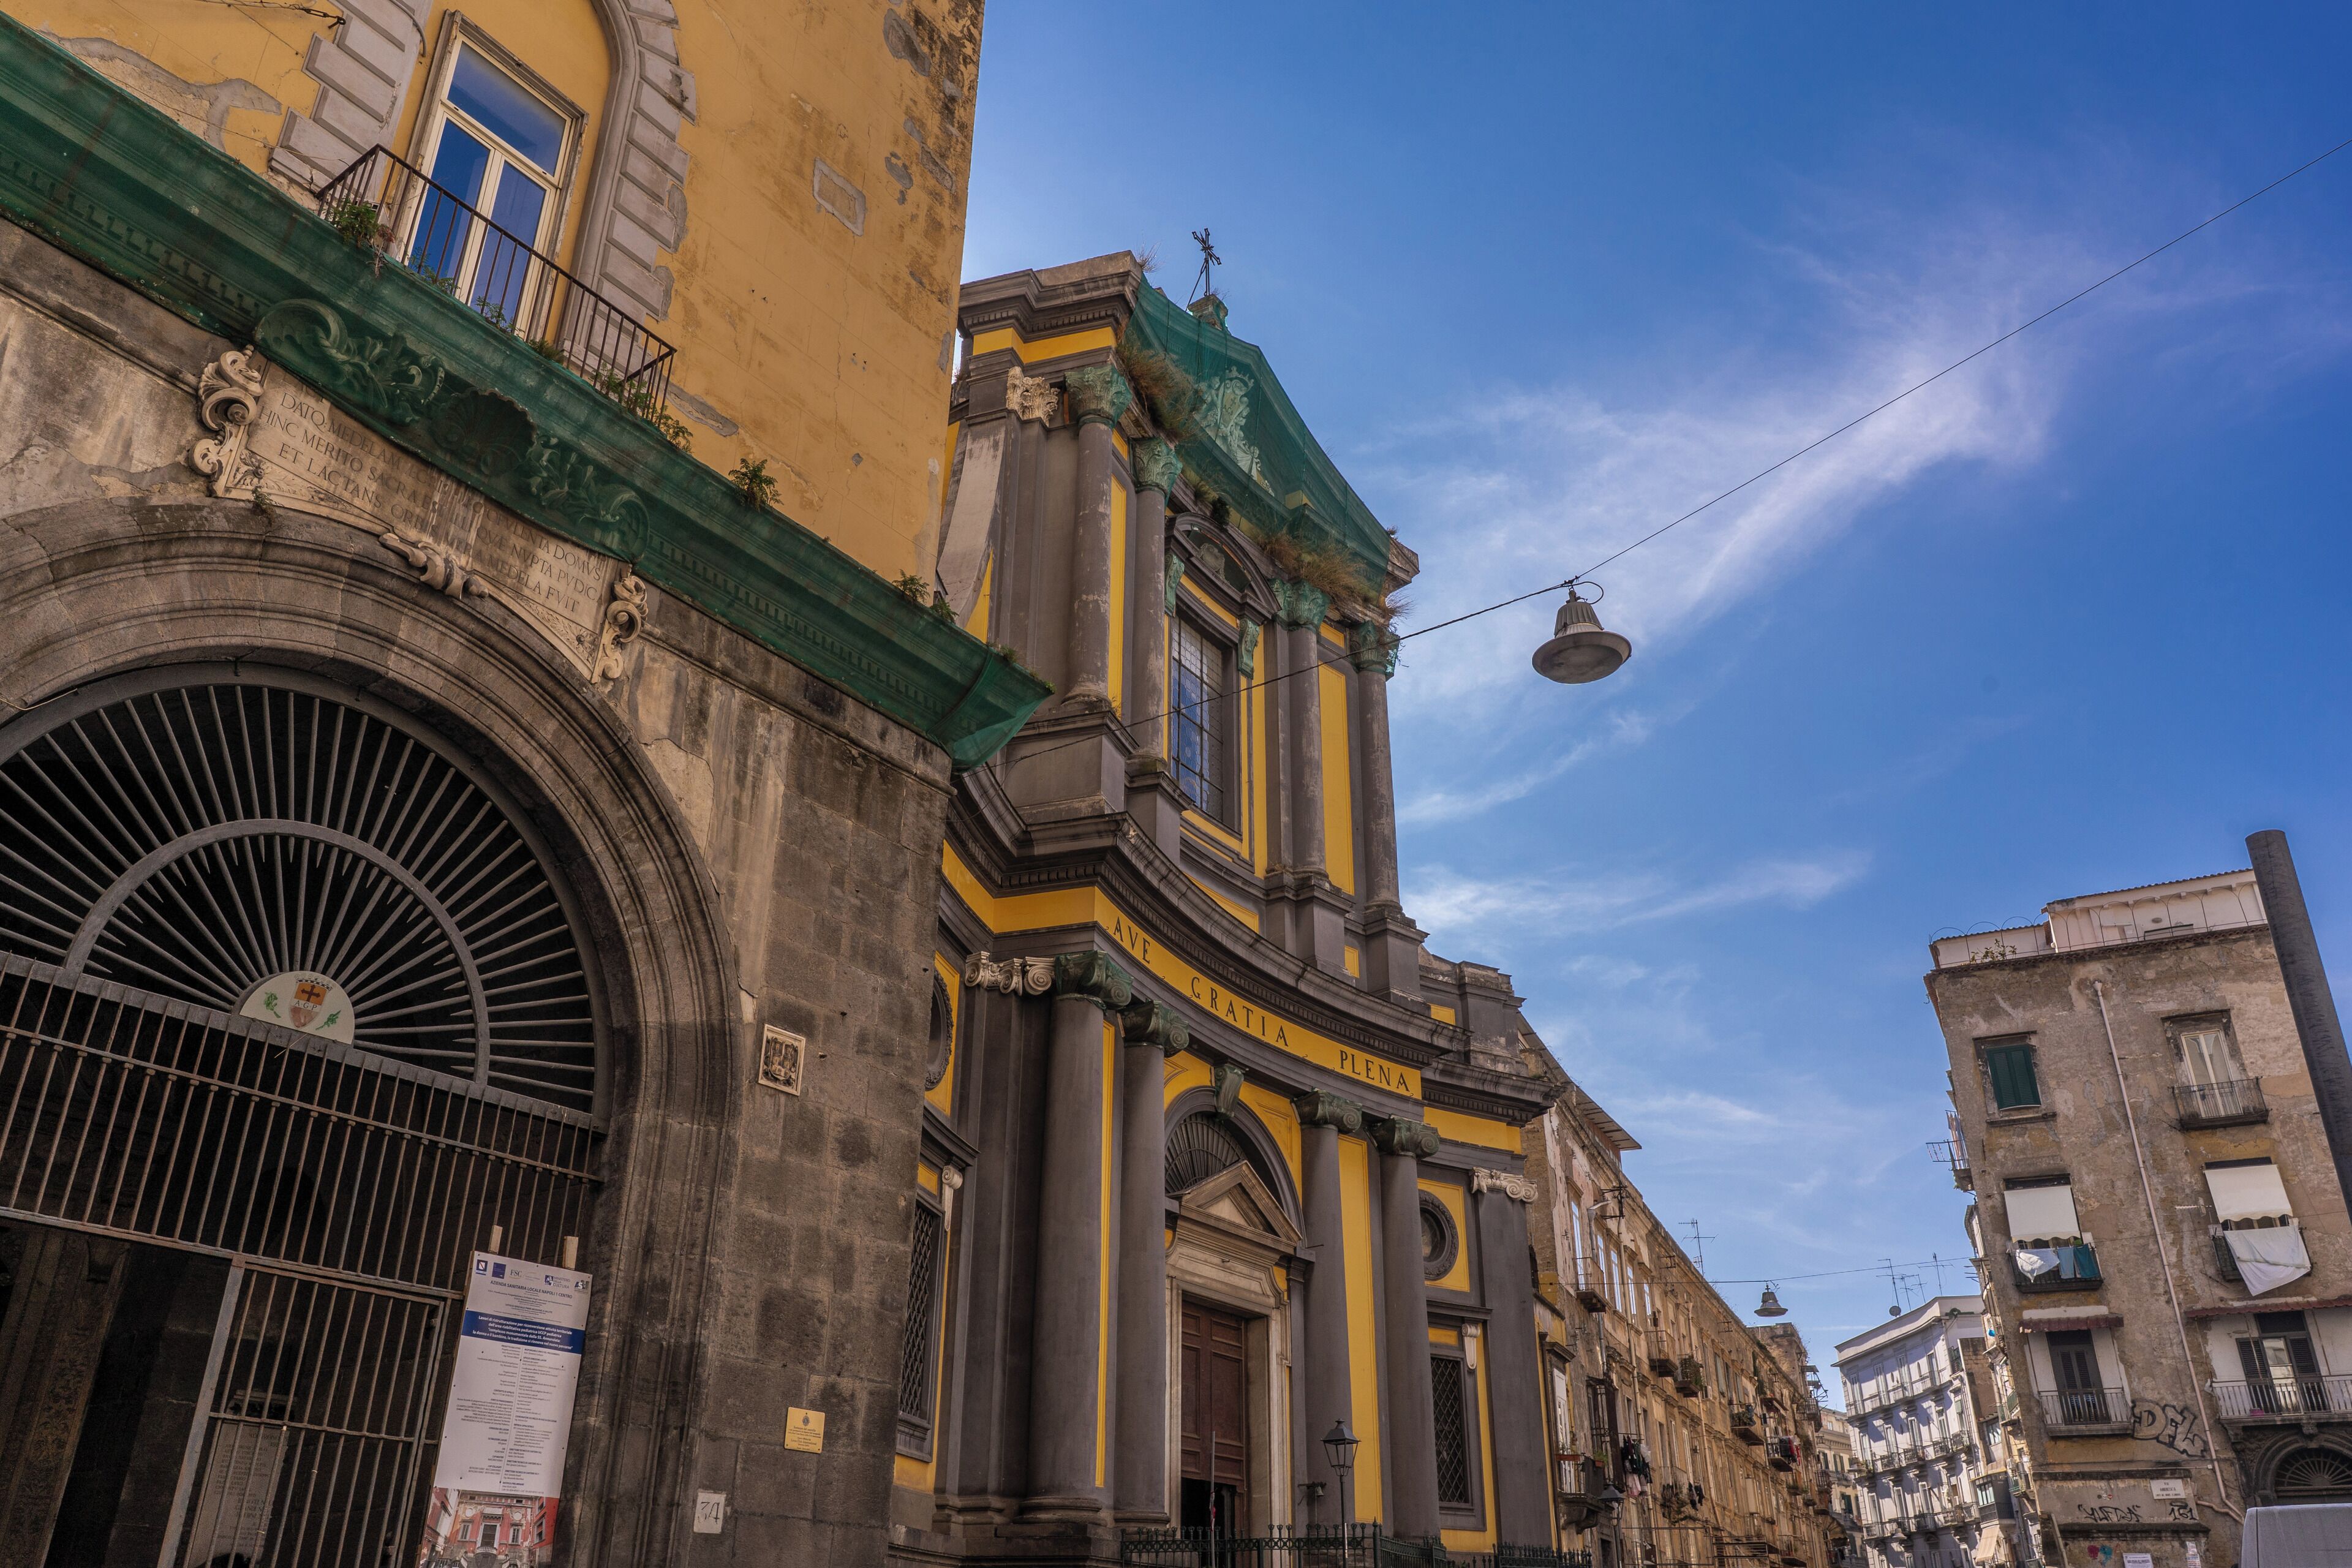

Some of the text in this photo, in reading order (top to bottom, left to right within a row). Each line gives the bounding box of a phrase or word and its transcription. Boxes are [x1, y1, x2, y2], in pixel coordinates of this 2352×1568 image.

[258, 405, 299, 437] HINC
[301, 429, 363, 472] MERITO
[368, 466, 416, 503] SACRA
[511, 543, 552, 578] NVPTA
[278, 442, 303, 464] ET
[306, 458, 382, 508] LACTANS
[488, 557, 541, 594] MEDELA
[545, 586, 580, 612] FVIT
[553, 544, 601, 581] DOMVS
[1113, 916, 1411, 1093] AVE GRATIA PLENA
[510, 1269, 522, 1278] FSC
